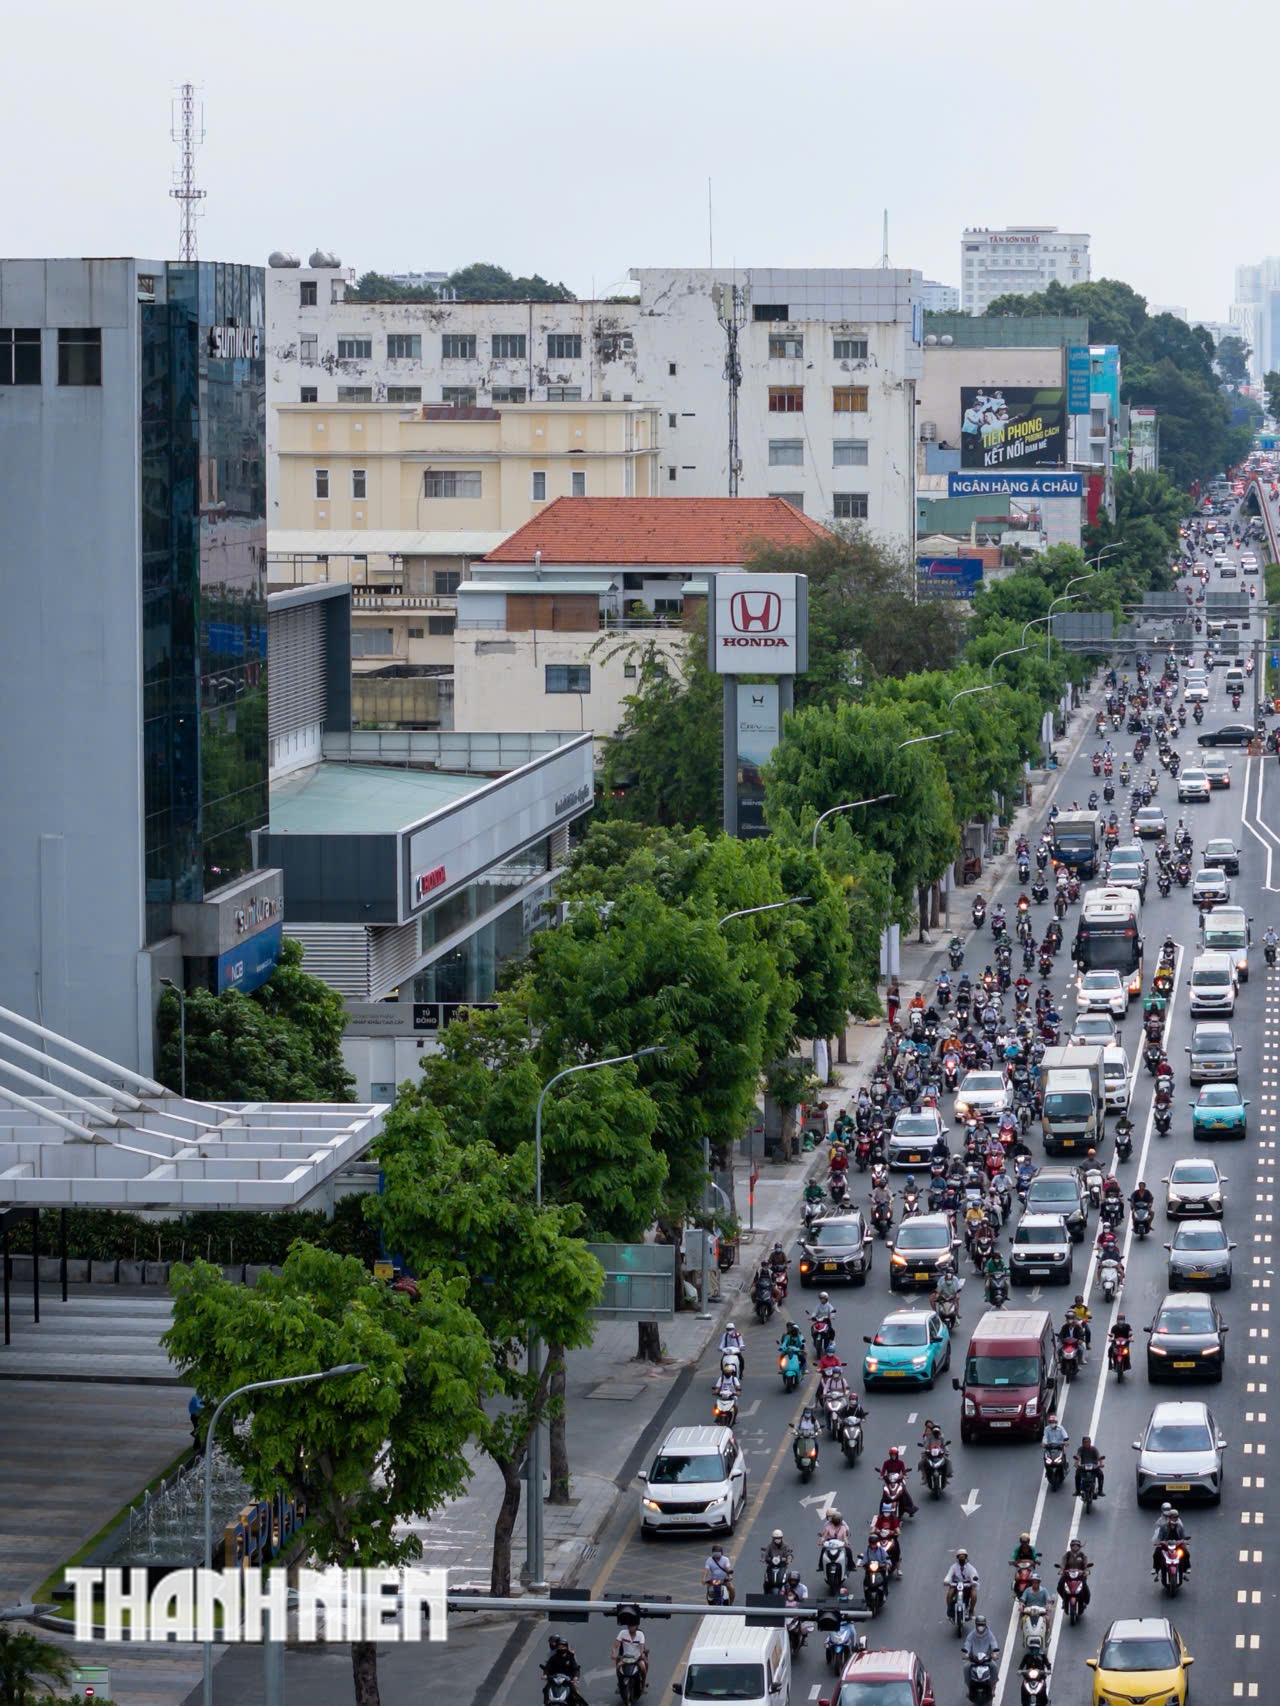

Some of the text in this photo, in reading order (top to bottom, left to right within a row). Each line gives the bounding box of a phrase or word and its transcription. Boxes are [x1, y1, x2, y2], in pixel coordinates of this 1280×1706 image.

[1008, 417, 1043, 441] PHONG
[1006, 438, 1025, 460] NỐI
[953, 479, 1078, 492] NGÂN HÀNG Á CHÂU
[723, 638, 789, 647] HONDA
